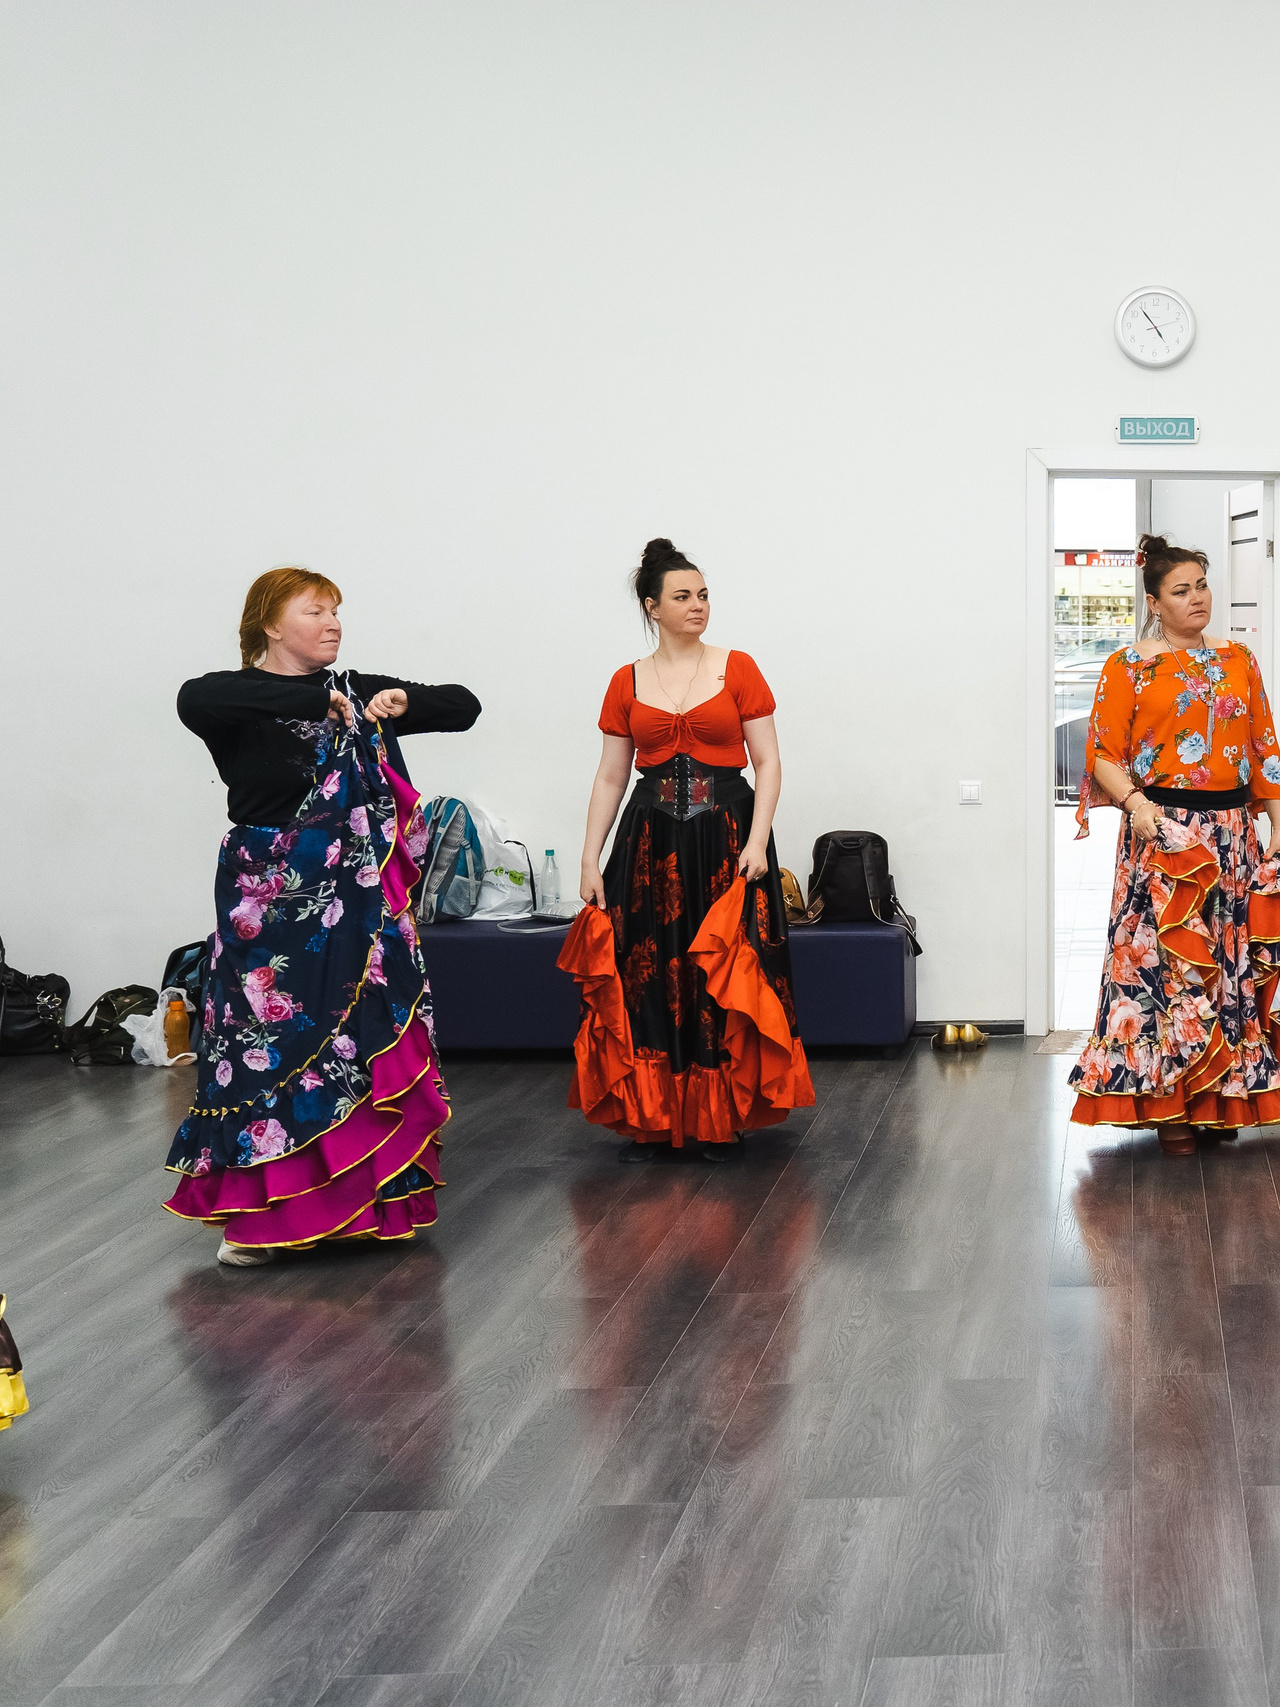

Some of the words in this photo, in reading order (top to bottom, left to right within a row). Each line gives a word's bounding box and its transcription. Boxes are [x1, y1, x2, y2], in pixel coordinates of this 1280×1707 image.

[1152, 298, 1160, 306] 12
[1166, 302, 1170, 310] 1
[1130, 310, 1139, 318] 10
[1175, 311, 1181, 320] 2
[1126, 322, 1132, 330] 9
[1178, 325, 1184, 333] 3
[1129, 335, 1136, 343] 8
[1139, 344, 1145, 353] 7
[1151, 348, 1158, 357] 6
[1165, 345, 1170, 354] 5
[1124, 421, 1190, 437] ВЫХОД
